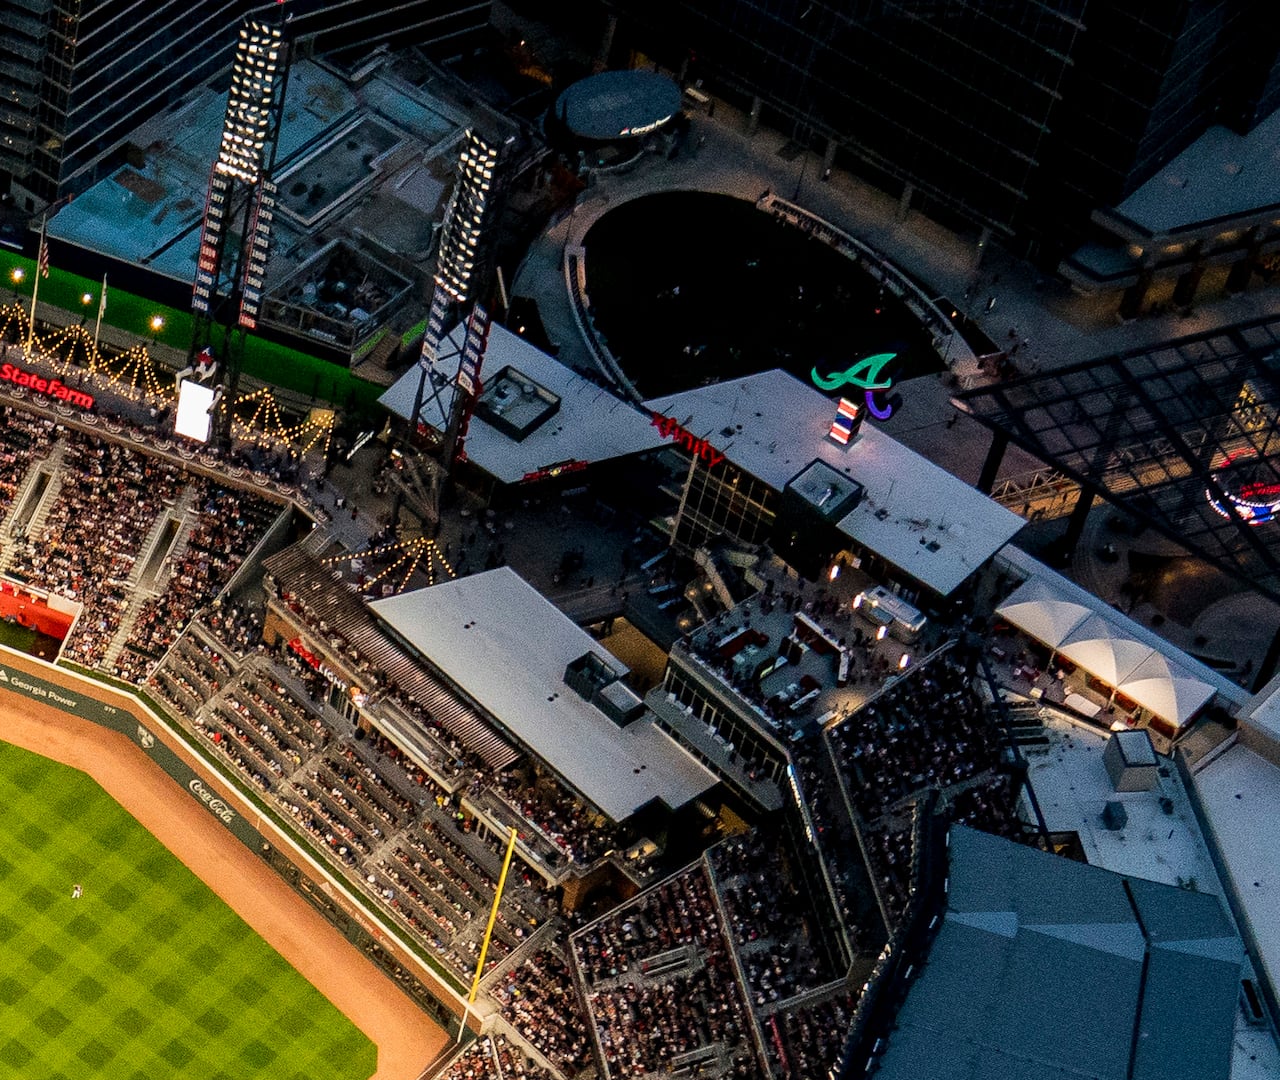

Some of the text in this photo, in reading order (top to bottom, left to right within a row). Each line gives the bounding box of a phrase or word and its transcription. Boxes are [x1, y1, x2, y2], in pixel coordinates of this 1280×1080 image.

[10, 677, 77, 708] Georgia Power
[189, 778, 234, 824] Coca-Cola
